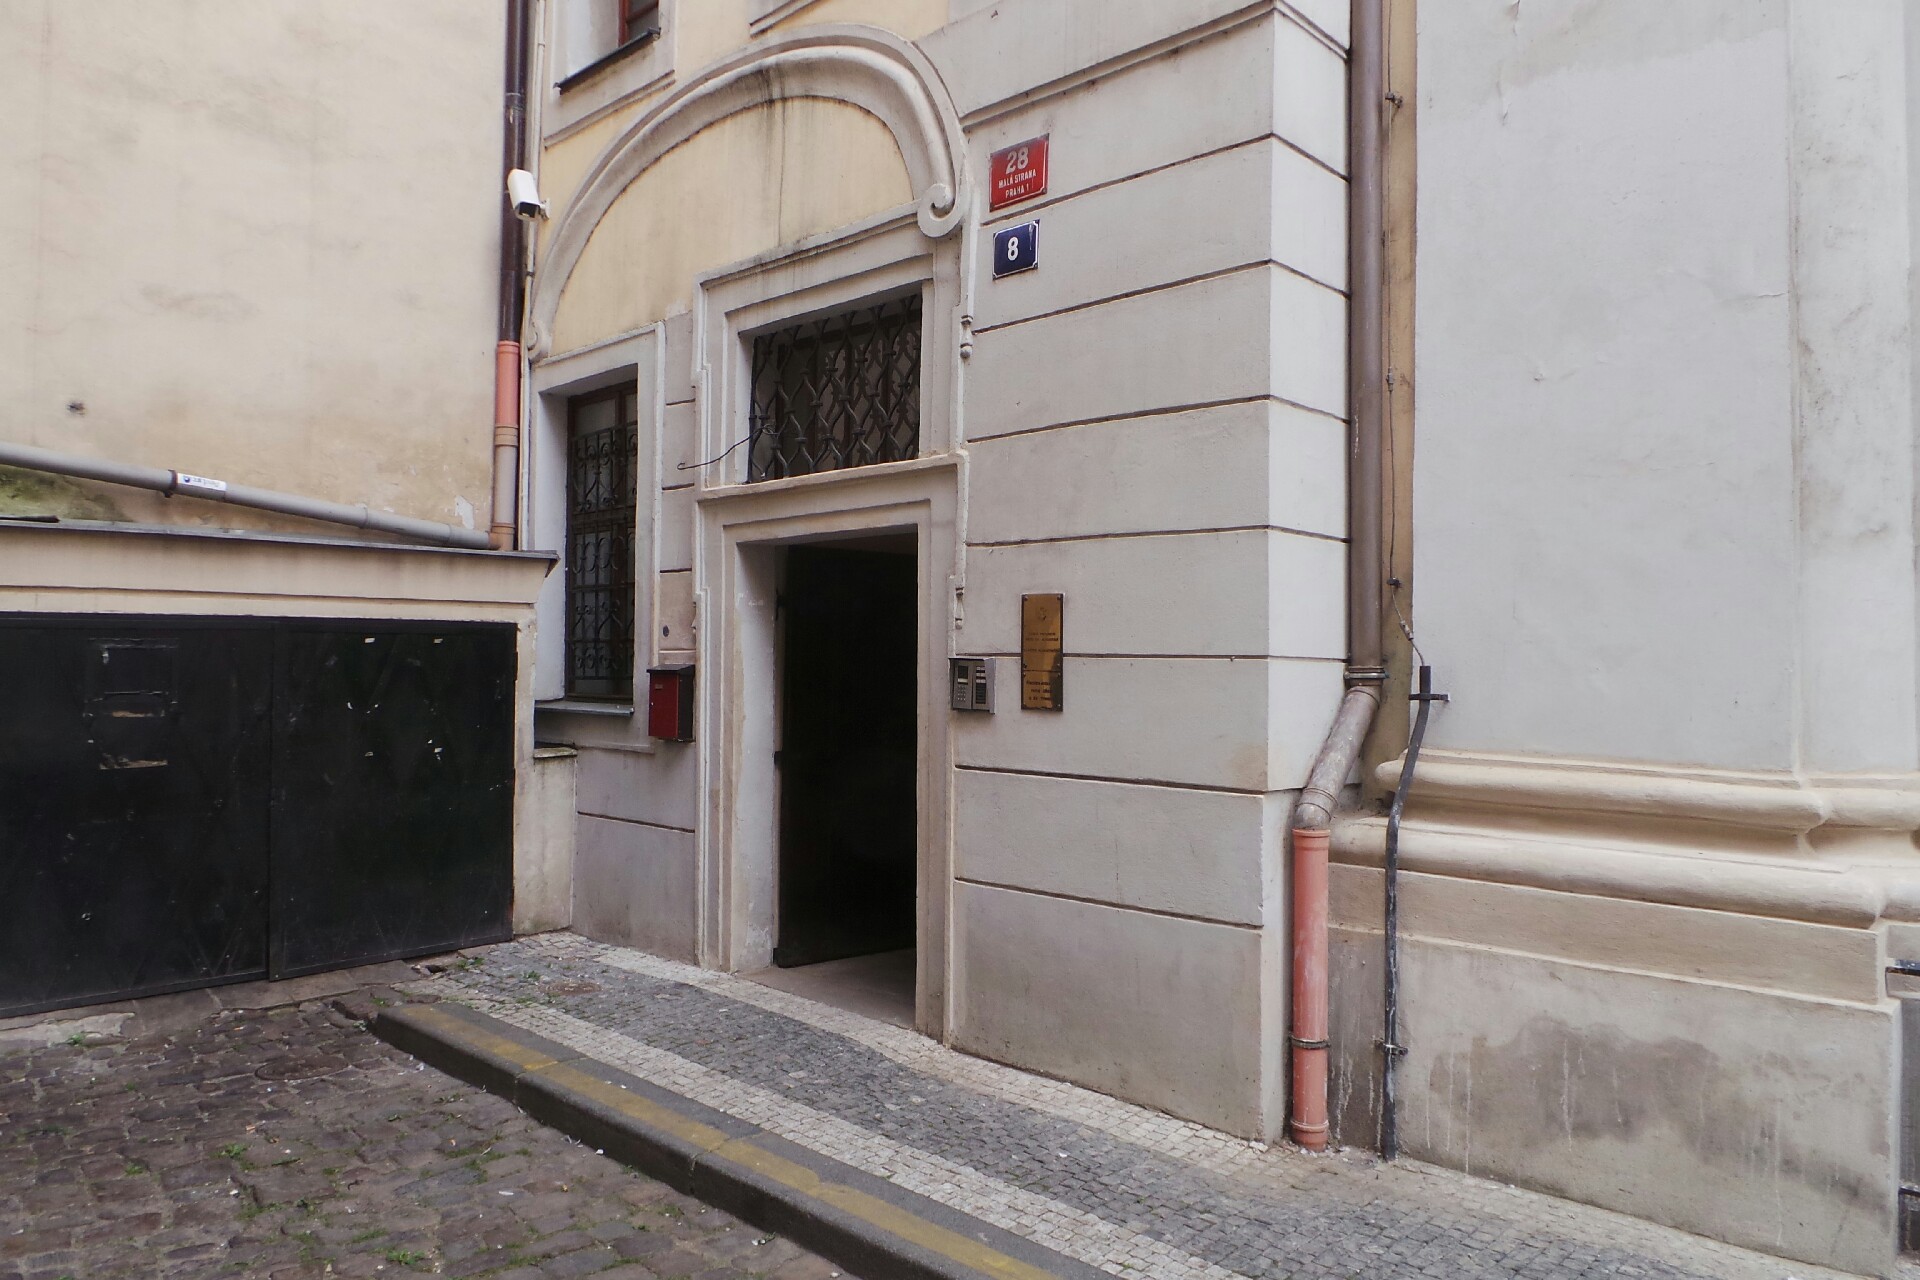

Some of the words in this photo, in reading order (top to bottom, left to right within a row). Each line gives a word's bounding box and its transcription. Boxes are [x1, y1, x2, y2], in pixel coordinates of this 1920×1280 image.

[1005, 146, 1029, 175] 28
[998, 174, 1014, 189] MALÁ
[1014, 168, 1037, 184] STRANA
[1005, 184, 1025, 199] PRAHA
[1026, 182, 1029, 192] 1
[1007, 236, 1019, 261] 8
